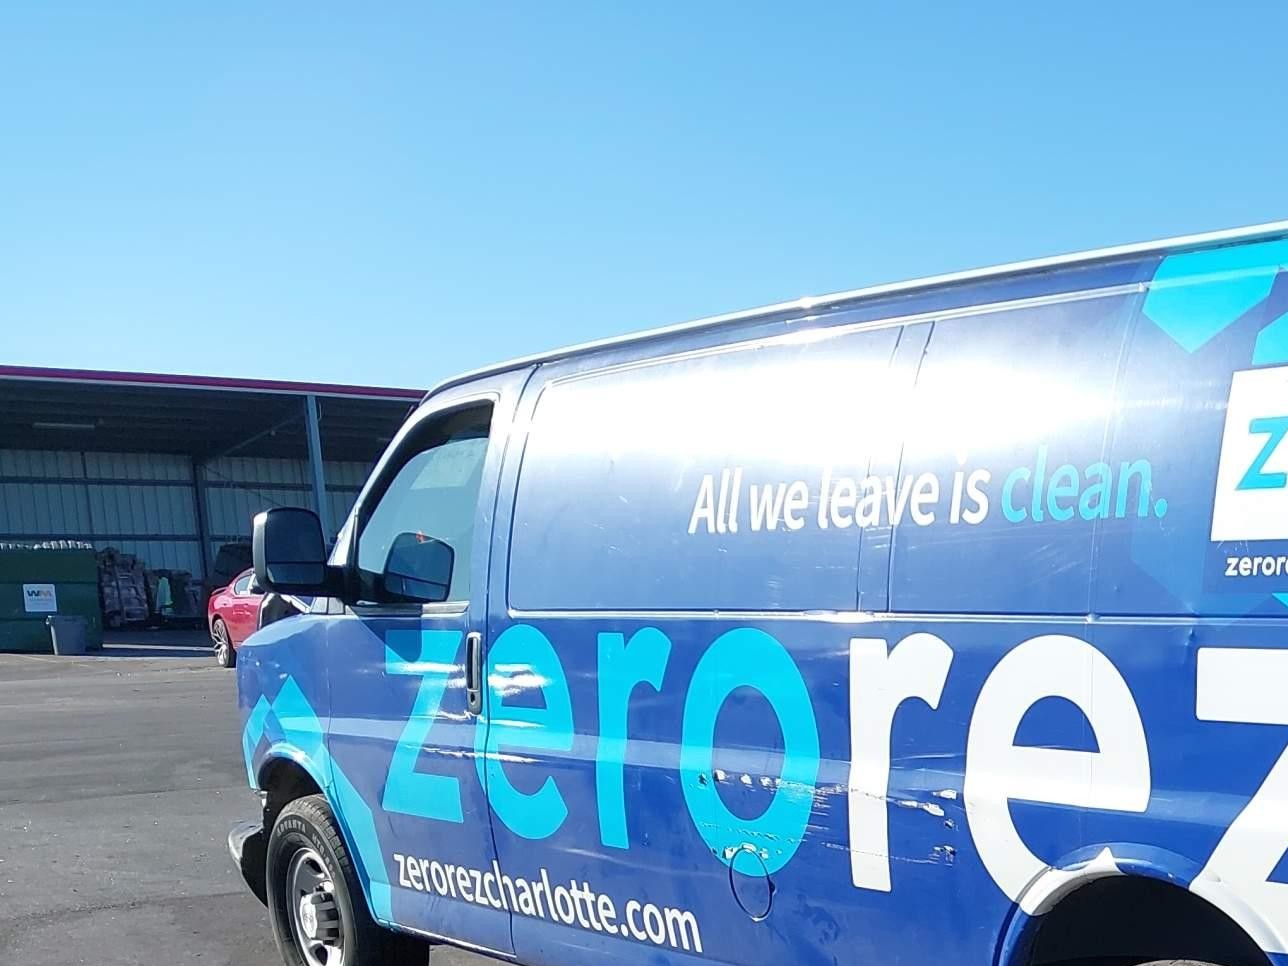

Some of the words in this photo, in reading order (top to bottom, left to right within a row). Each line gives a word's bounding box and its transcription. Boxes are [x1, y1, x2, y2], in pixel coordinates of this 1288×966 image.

[688, 467, 742, 533] All
[749, 475, 808, 531] we
[816, 464, 939, 529] leave
[949, 447, 991, 524] is
[1001, 444, 1168, 523] clean.
[393, 853, 703, 952] zerorezcharlotte.com
